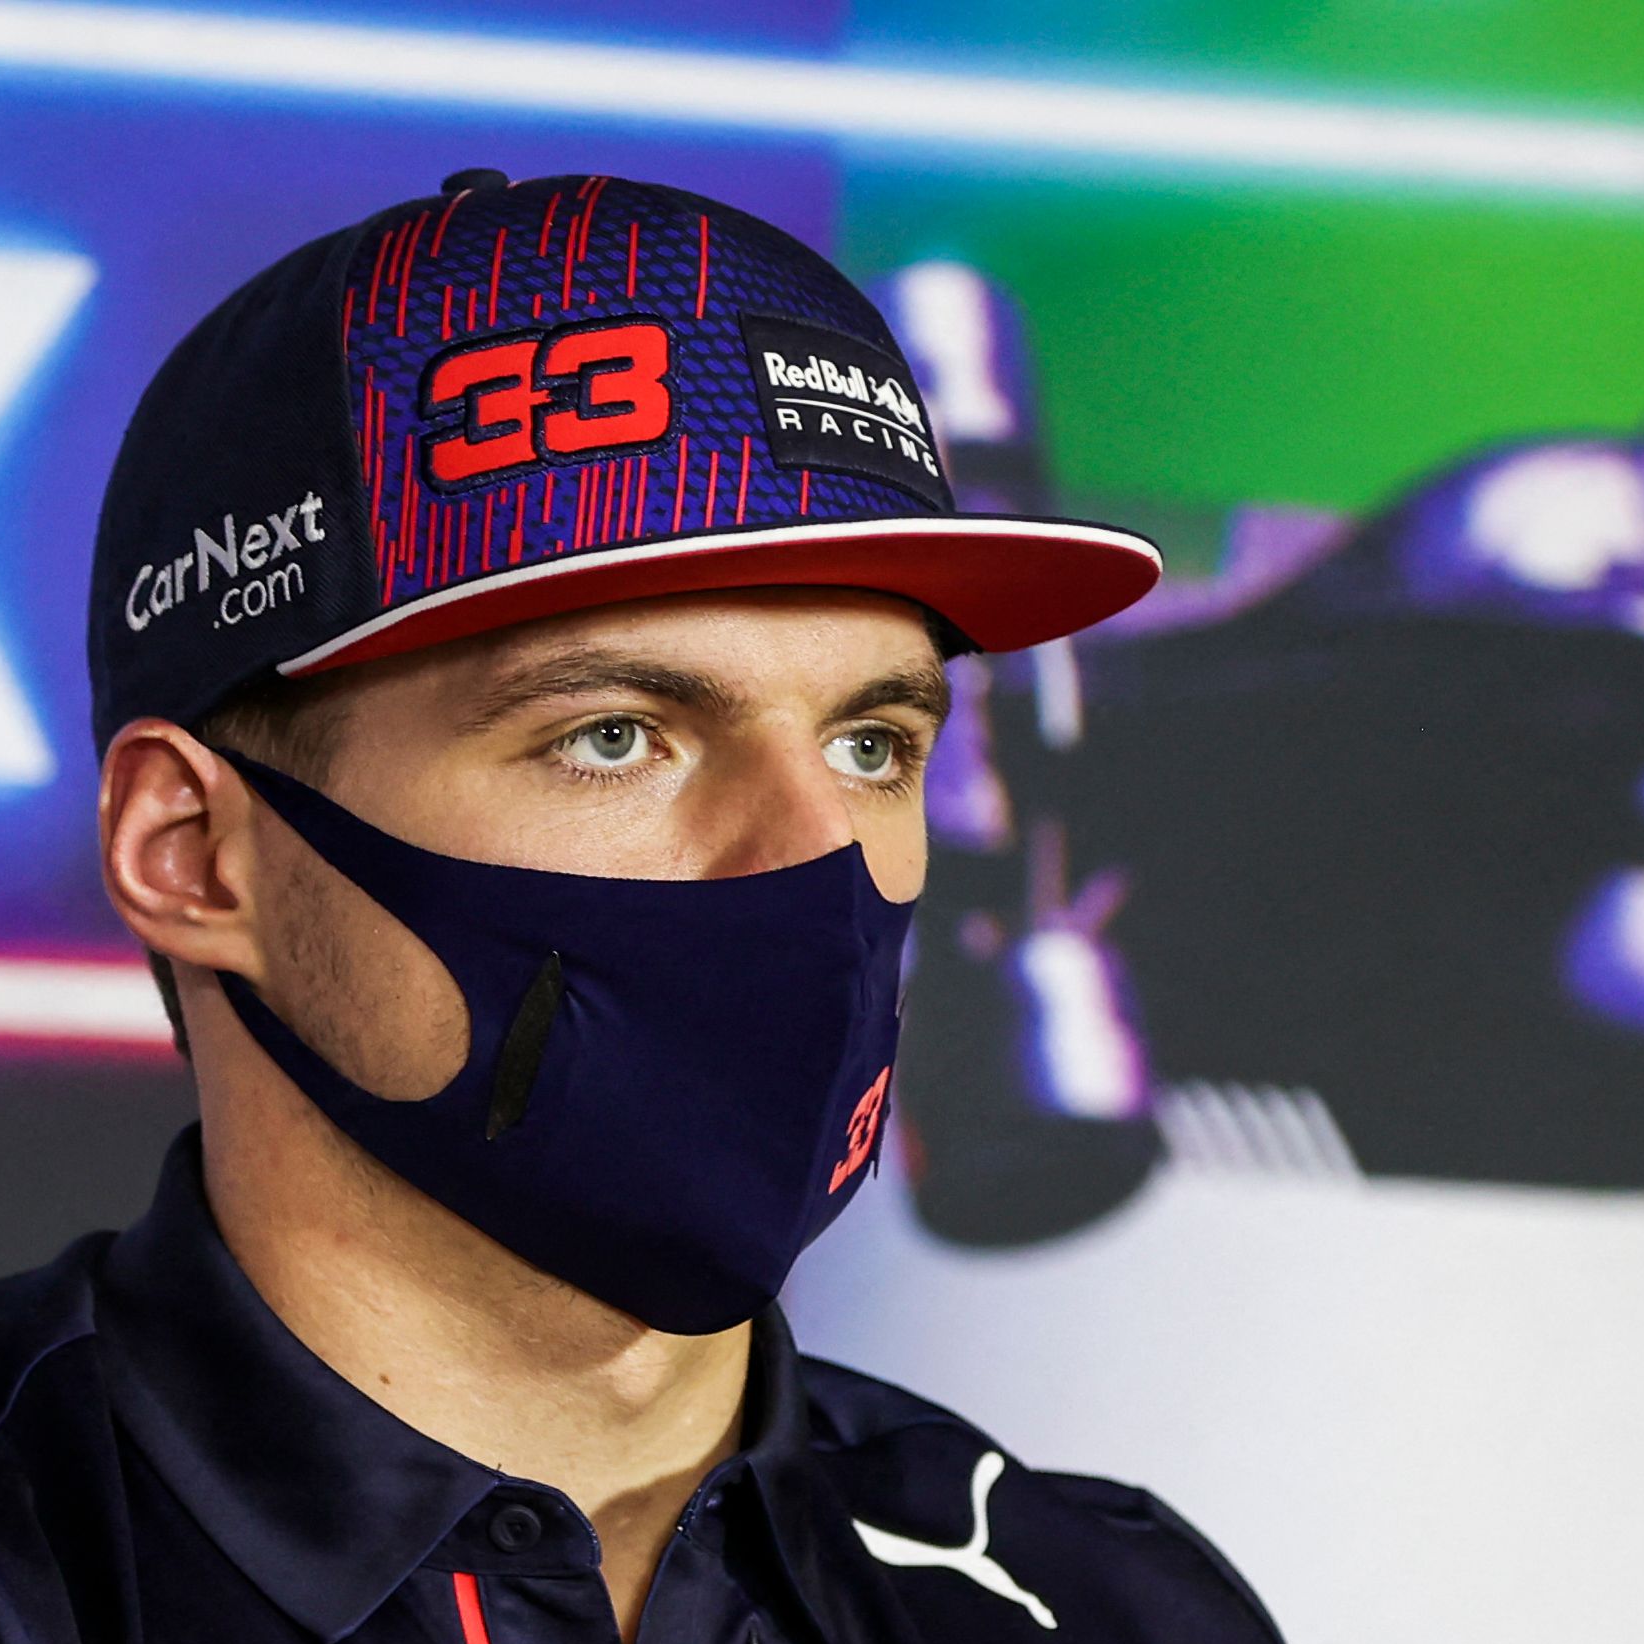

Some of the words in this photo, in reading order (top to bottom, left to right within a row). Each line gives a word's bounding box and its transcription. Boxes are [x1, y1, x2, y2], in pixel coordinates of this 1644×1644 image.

[429, 322, 674, 482] 33
[776, 407, 939, 478] RACING
[125, 490, 326, 632] CarNext
[213, 562, 305, 629] .com
